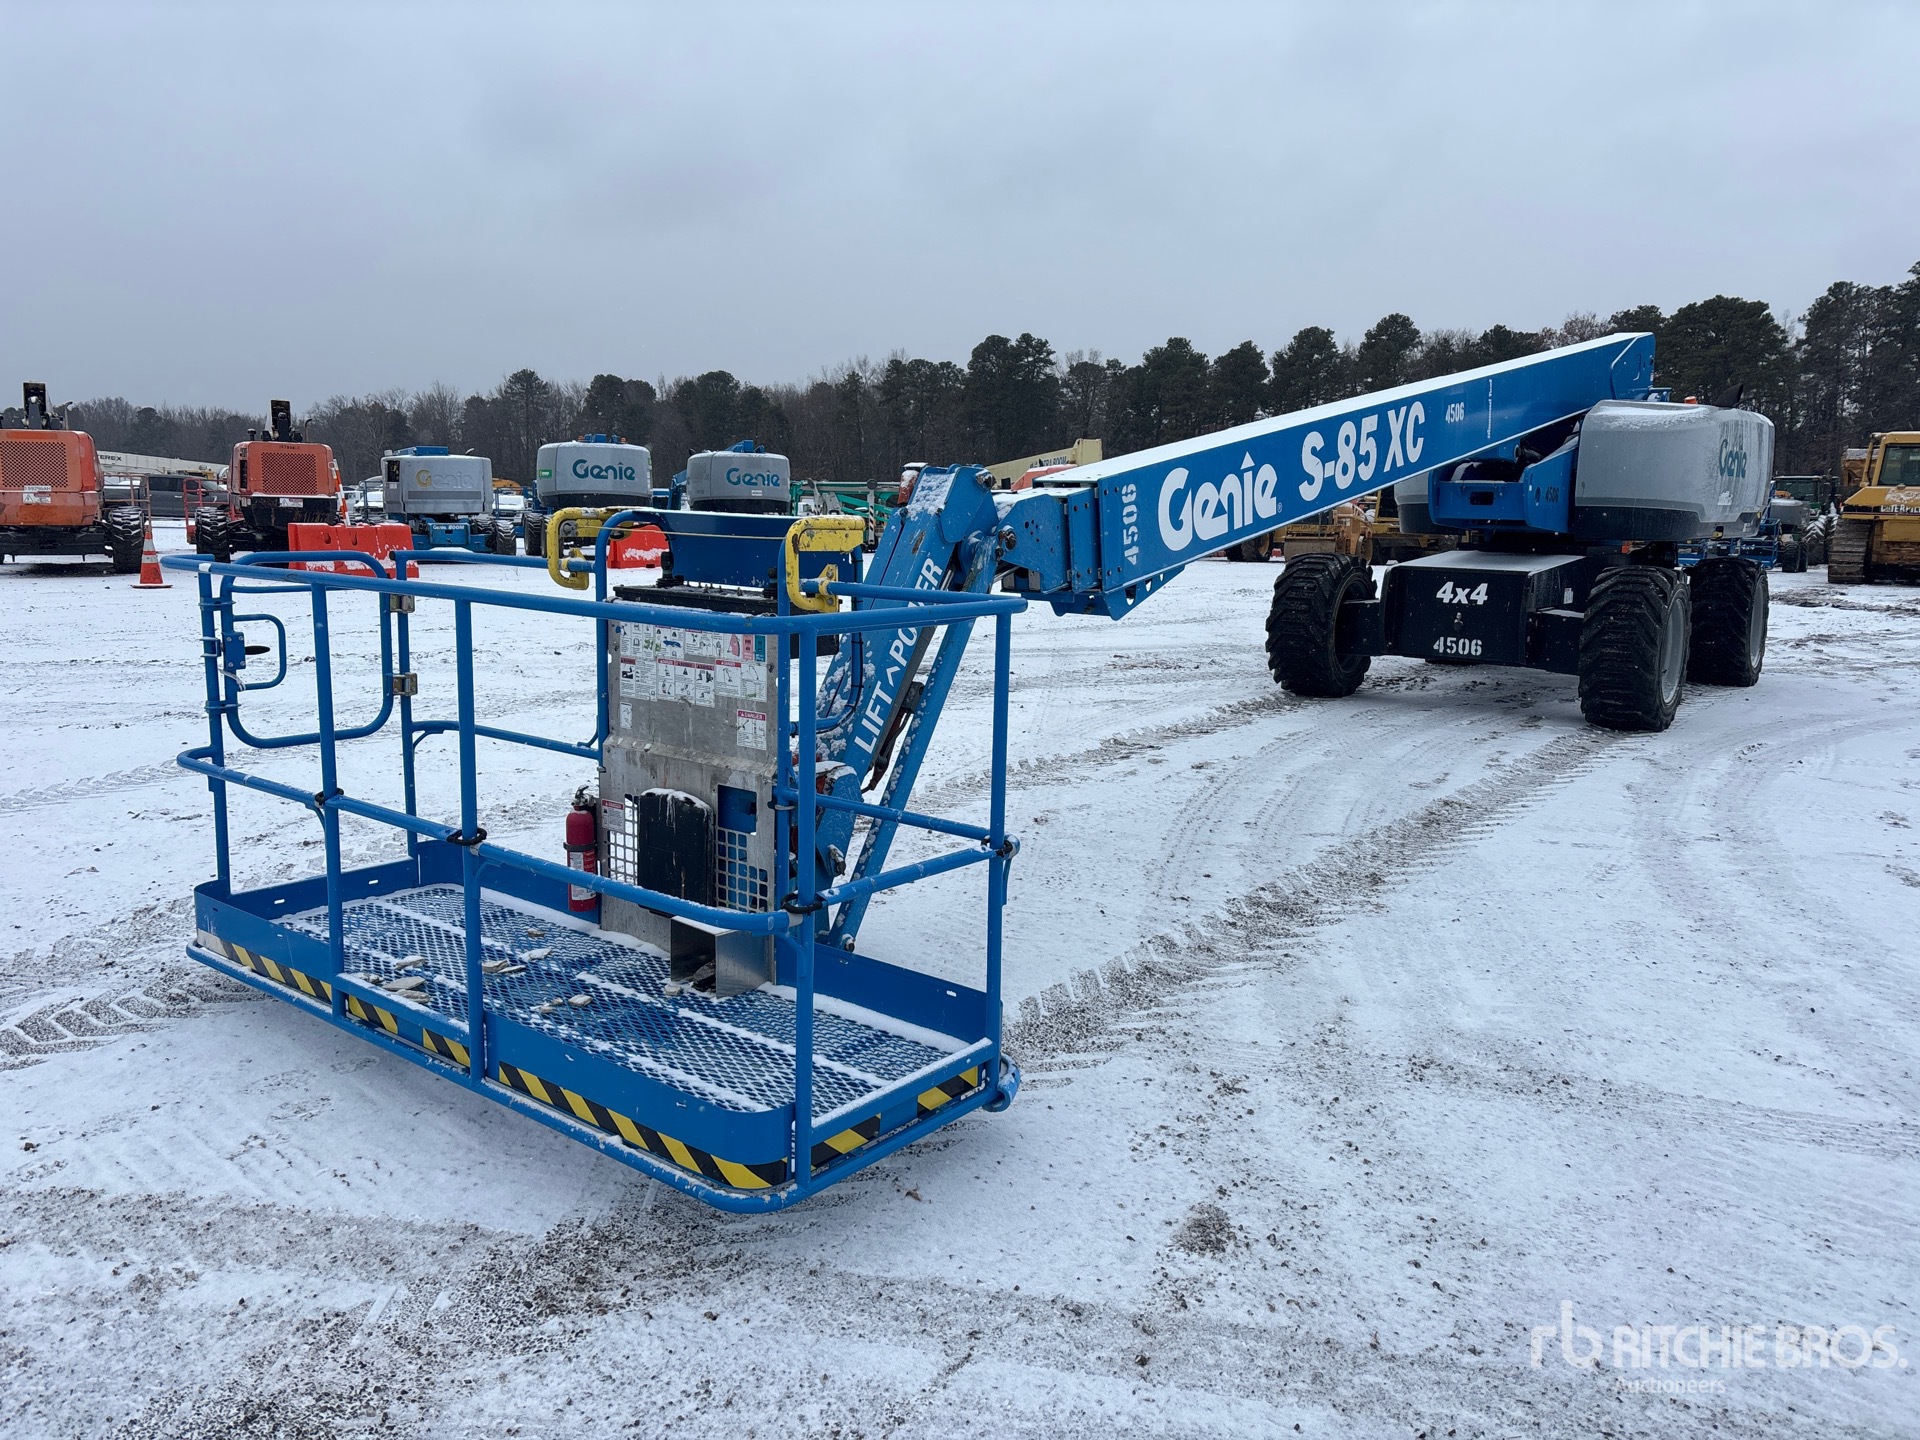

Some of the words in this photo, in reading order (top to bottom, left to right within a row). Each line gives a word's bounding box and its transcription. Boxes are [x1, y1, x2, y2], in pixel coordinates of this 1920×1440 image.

[1445, 402, 1465, 424] 4506
[1298, 414, 1378, 501] S-85
[1383, 401, 1425, 473] XC
[1719, 438, 1747, 479] Genie
[416, 469, 473, 489] Genie
[572, 458, 636, 481] Genie
[725, 467, 780, 487] Genie
[1158, 451, 1278, 551] Genie
[1121, 483, 1139, 565] 4506
[1435, 581, 1488, 605] 4x4
[854, 681, 892, 754] LIFT
[889, 557, 943, 668] POER
[1432, 636, 1483, 656] 4506
